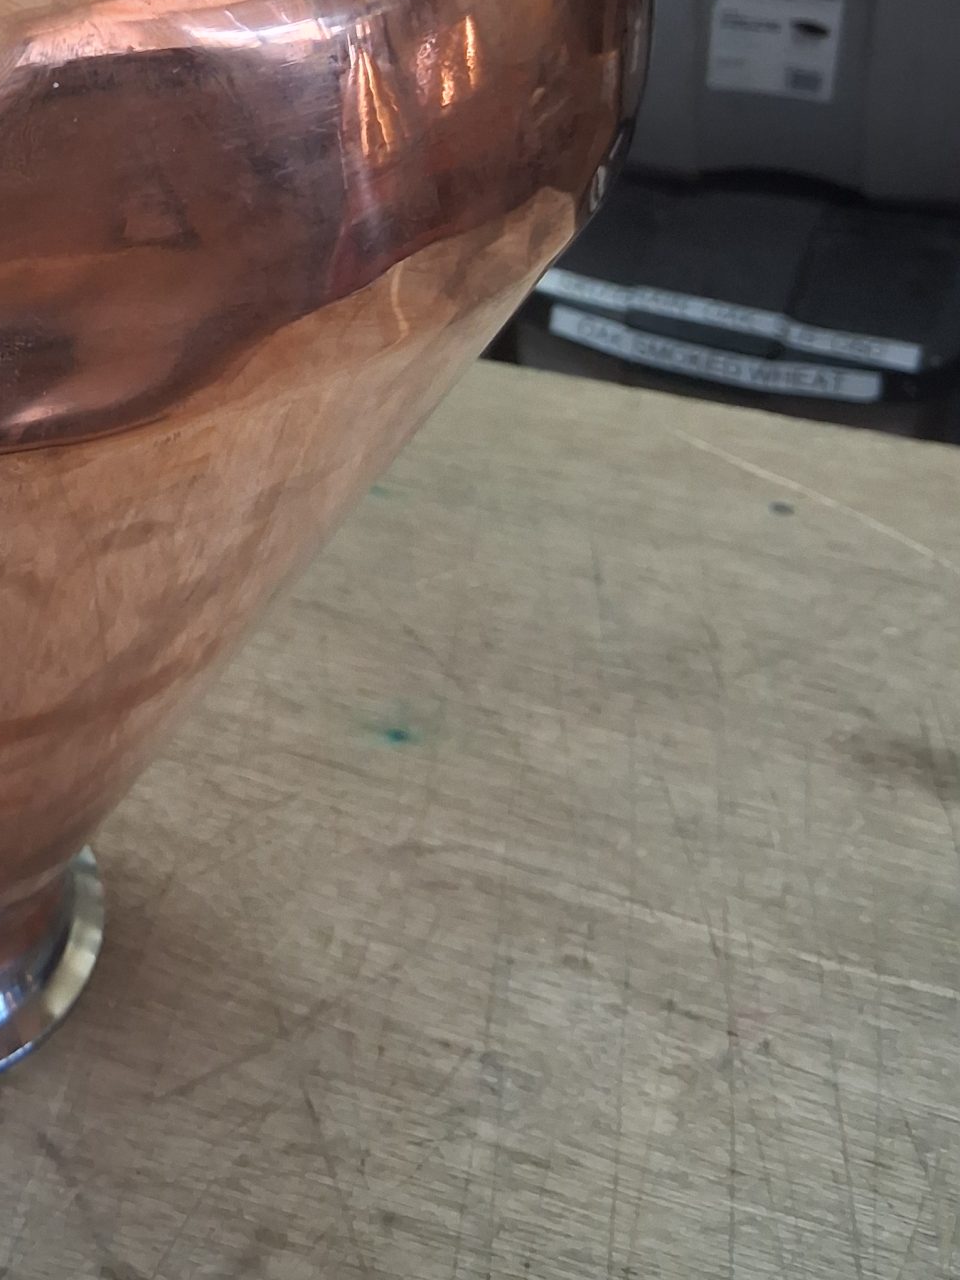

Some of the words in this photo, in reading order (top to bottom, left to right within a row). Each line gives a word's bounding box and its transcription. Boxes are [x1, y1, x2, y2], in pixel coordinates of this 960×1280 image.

[576, 316, 624, 347] OAK
[635, 332, 741, 378] SMOKED
[745, 362, 840, 394] WHEAT
